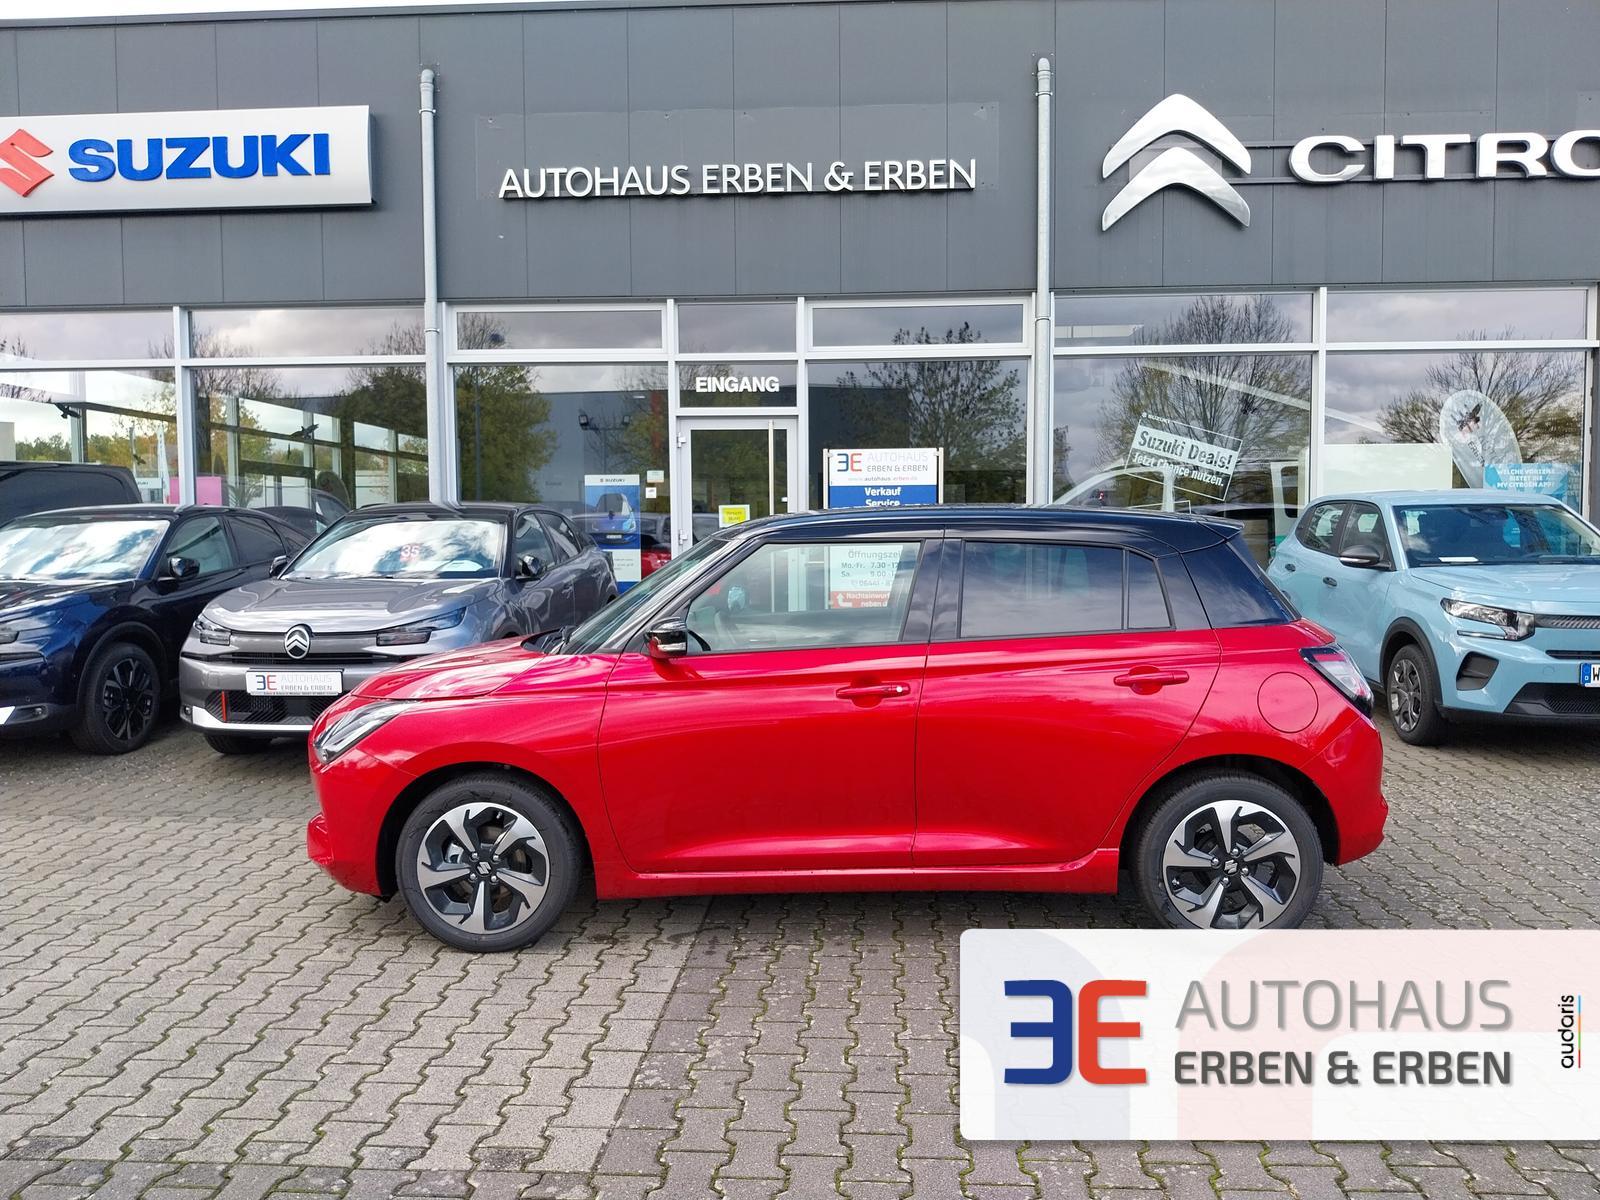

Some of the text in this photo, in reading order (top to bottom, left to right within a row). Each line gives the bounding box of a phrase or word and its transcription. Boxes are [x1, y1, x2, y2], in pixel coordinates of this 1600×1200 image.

[68, 133, 331, 182] SUZUKI
[499, 158, 977, 198] AUTOHAUS ERBEN & ERBEN
[695, 376, 780, 393] EINGANG
[867, 452, 929, 462] AUTOHAUS
[1138, 430, 1233, 470] Suzuki Deals!
[1131, 452, 1224, 487] Jetzt Chance nutzen.
[864, 487, 902, 497] Verkauf
[401, 544, 421, 557] 35
